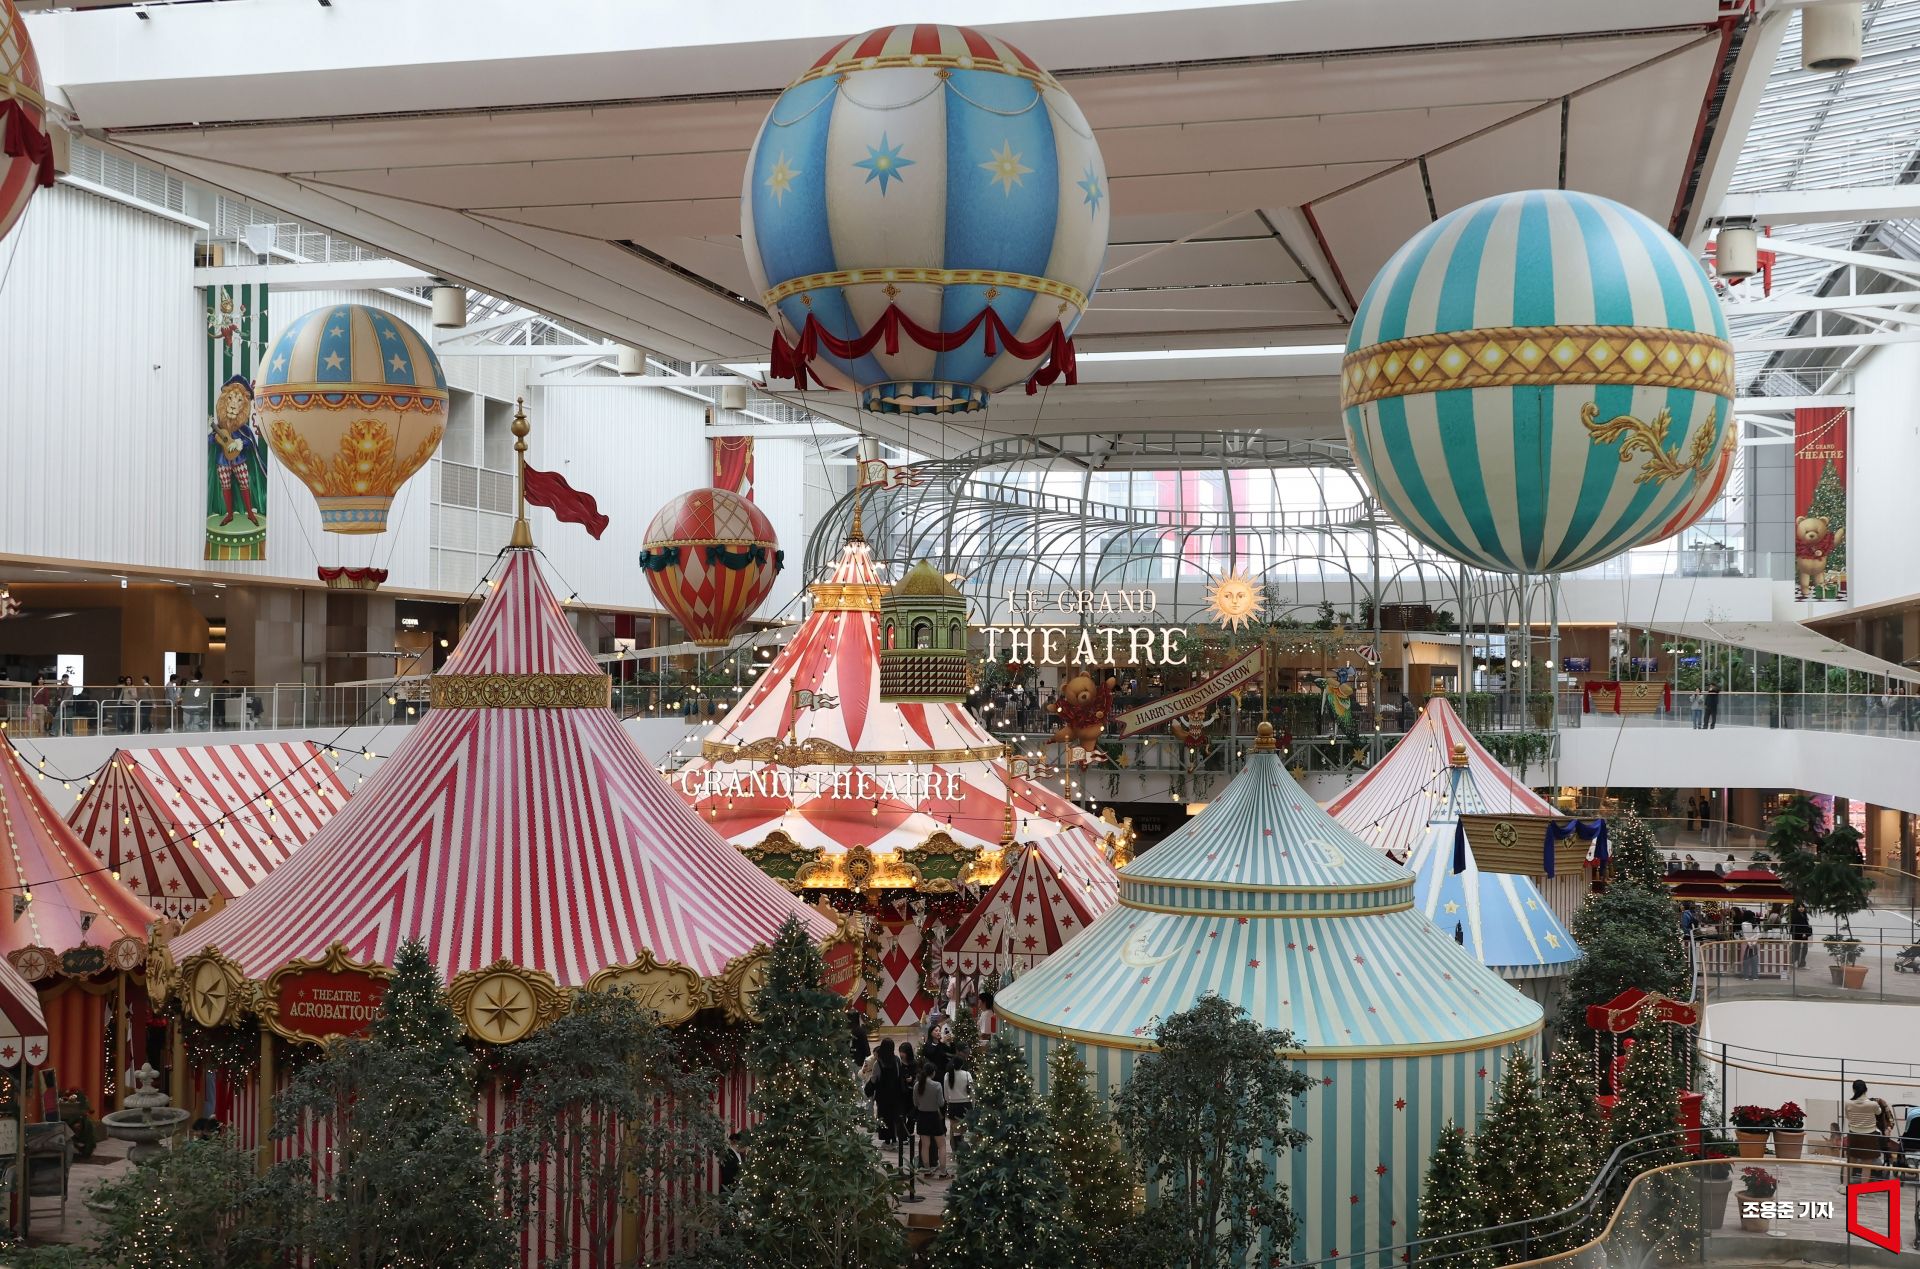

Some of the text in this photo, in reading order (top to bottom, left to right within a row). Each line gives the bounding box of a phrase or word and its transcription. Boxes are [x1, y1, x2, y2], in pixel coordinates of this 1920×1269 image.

[1799, 450, 1844, 459] THEATRE
[1007, 589, 1157, 614] LE GRAND
[979, 626, 1188, 666] THEATRE
[1135, 660, 1252, 726] HARRY'S CHRISTMAS SHOW
[681, 768, 967, 801] GRAND THEATRE
[312, 988, 361, 1003] THEATRE
